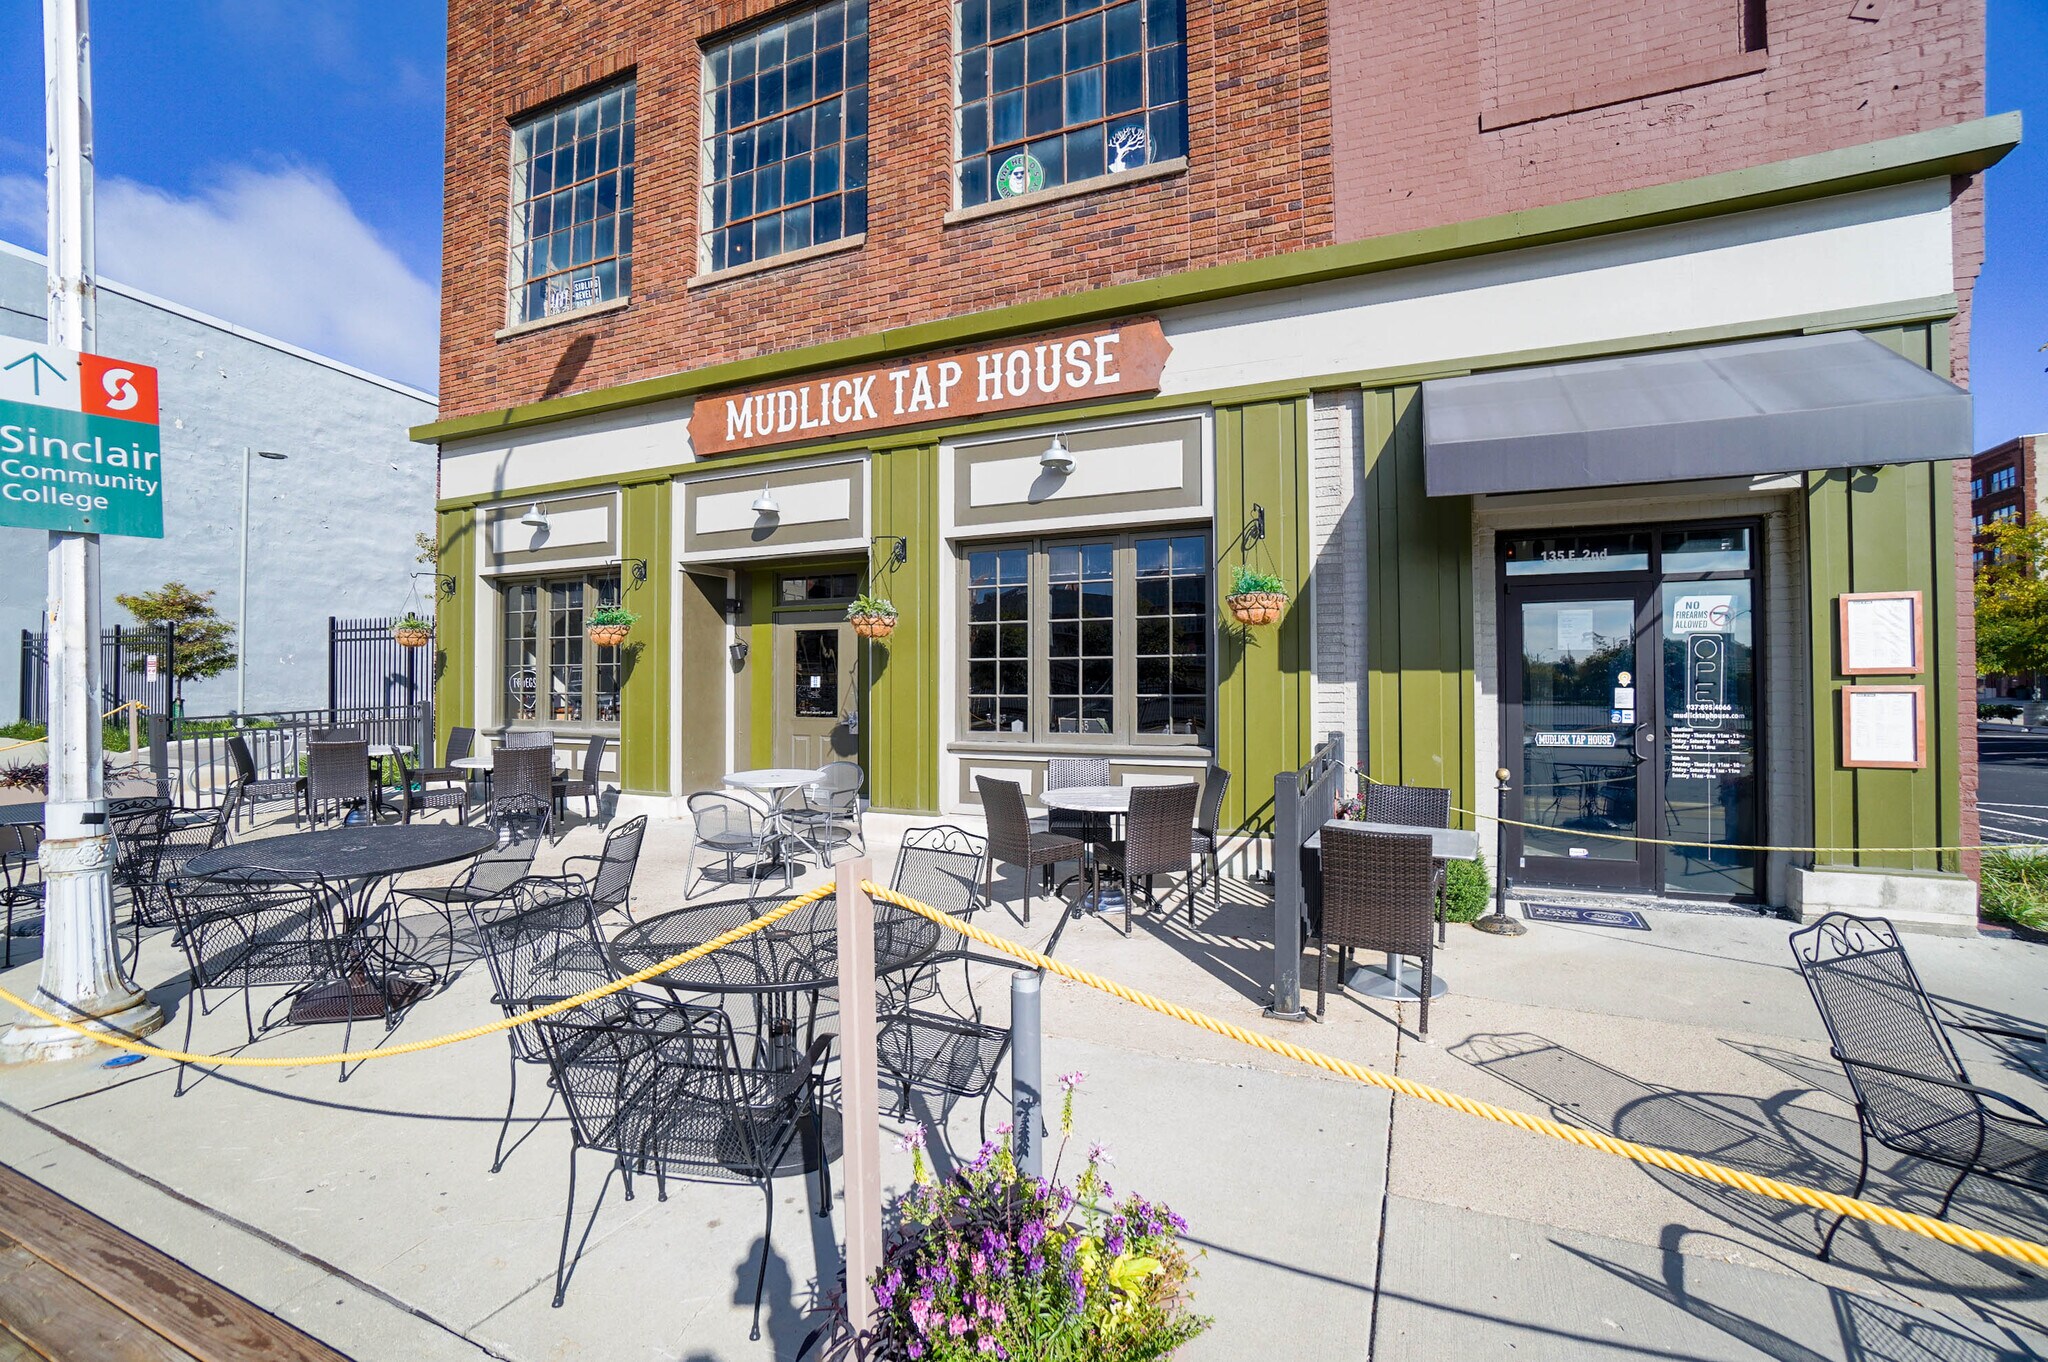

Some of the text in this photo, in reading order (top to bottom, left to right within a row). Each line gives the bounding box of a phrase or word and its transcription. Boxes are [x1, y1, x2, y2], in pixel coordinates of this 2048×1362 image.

[1000, 165, 1010, 181] FAT
[575, 288, 599, 300] REVELY
[725, 333, 1121, 441] MUDLICK TAP HOUSE
[0, 425, 158, 471] Sinclair
[1, 459, 158, 496] Community
[2, 484, 109, 511] College
[1540, 550, 1565, 563] 135
[1582, 548, 1608, 561] 2nd
[1685, 601, 1700, 610] NO
[1675, 610, 1708, 619] FIREARMS
[1675, 620, 1708, 629] ALLOWED
[1694, 638, 1718, 723] OPEN
[1539, 734, 1612, 745] MUDLICK TAP HOUSE
